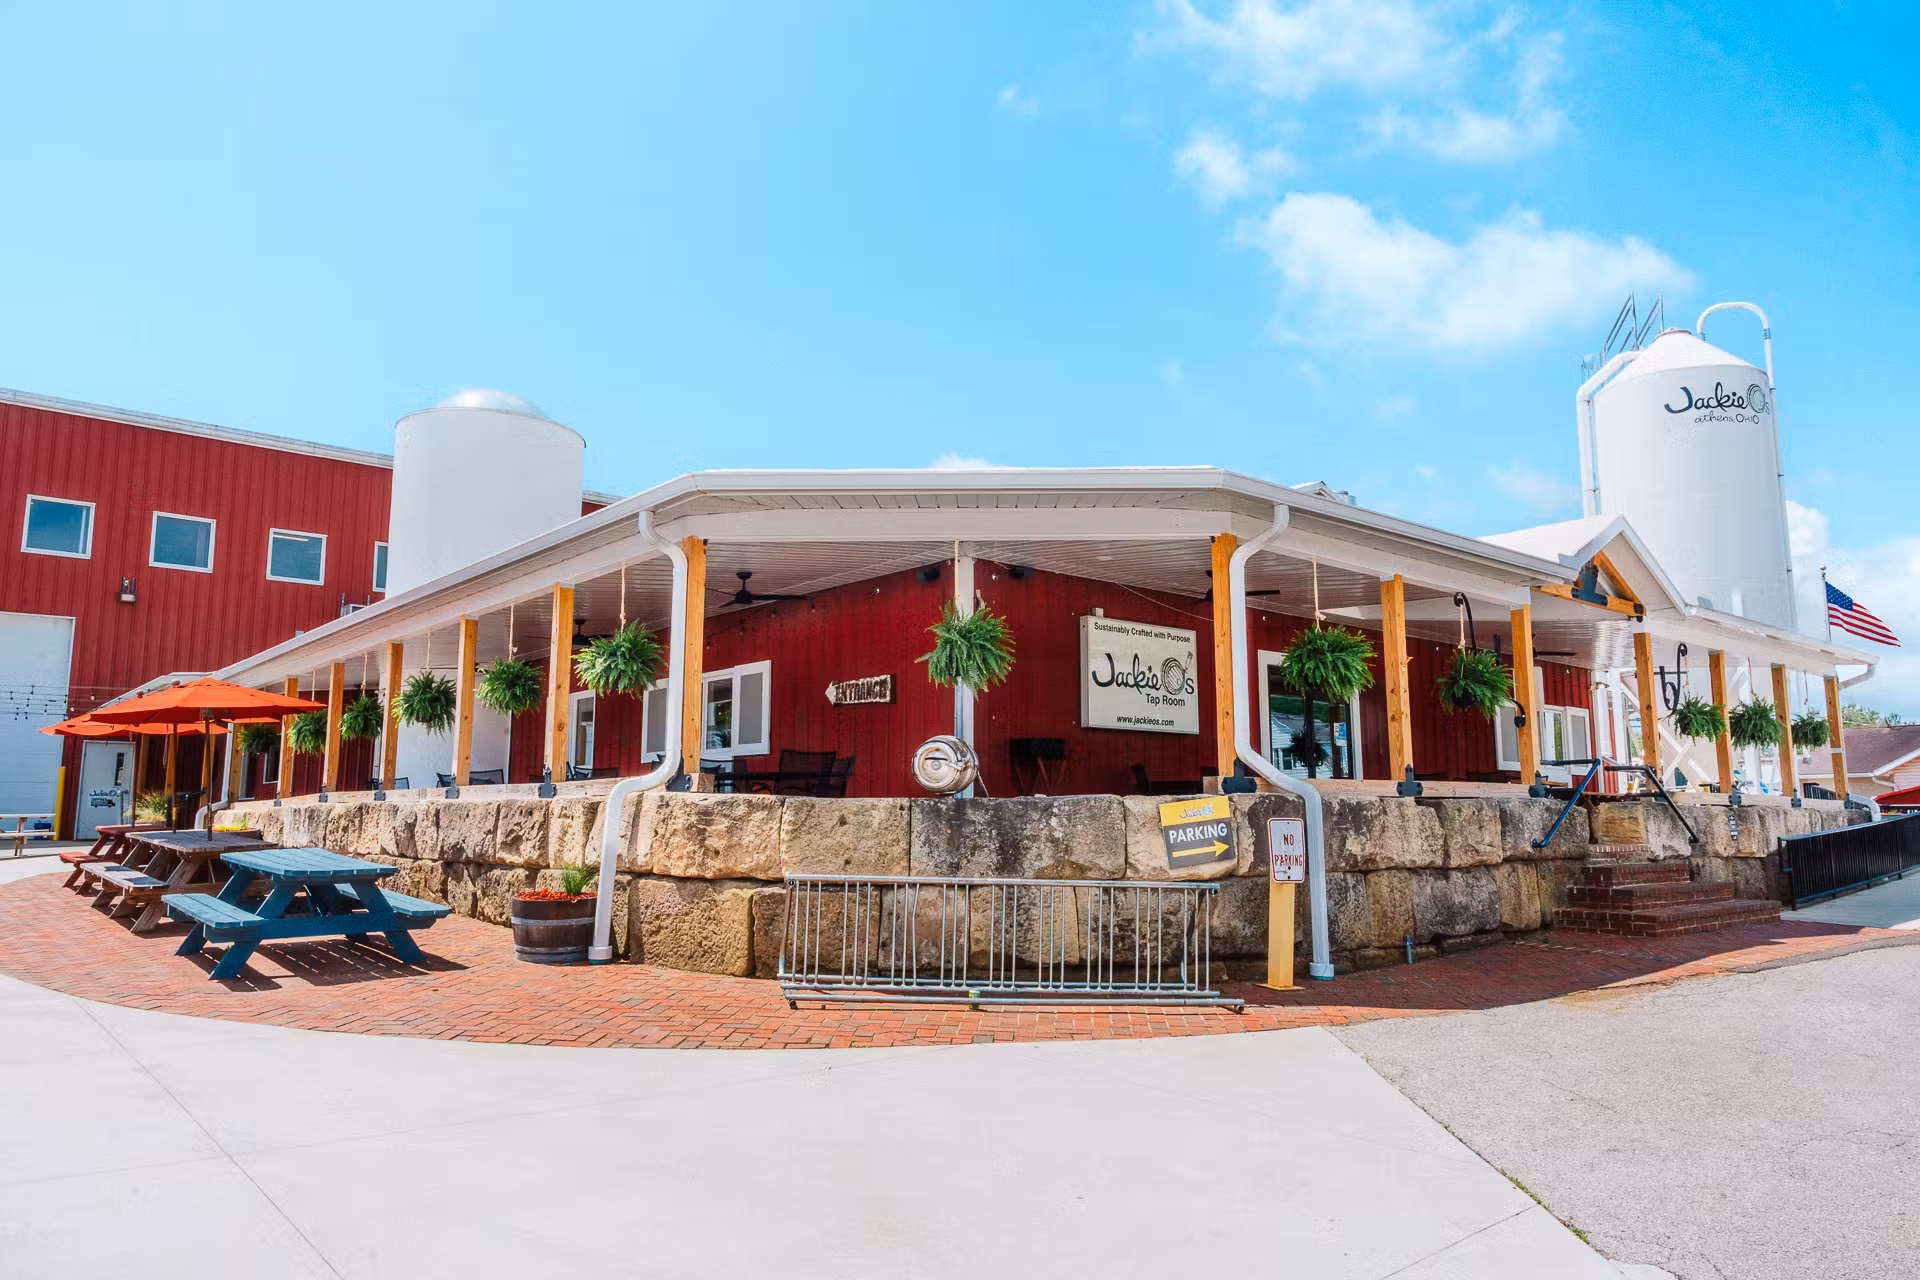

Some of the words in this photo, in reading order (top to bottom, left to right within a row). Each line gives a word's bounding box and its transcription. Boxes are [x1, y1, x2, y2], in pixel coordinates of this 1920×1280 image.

[1094, 622, 1130, 636] Sustainably
[1131, 627, 1153, 638] Crafted
[1154, 631, 1166, 640] with
[1167, 632, 1191, 643] Purpose
[835, 678, 889, 702] ENTRANCE
[1145, 693, 1160, 706] Tap
[1162, 695, 1185, 706] Room
[1116, 715, 1175, 727] www.jackieos.com
[1168, 822, 1228, 844] PARKING
[1283, 833, 1295, 846] NO
[1274, 854, 1303, 867] PARKING
